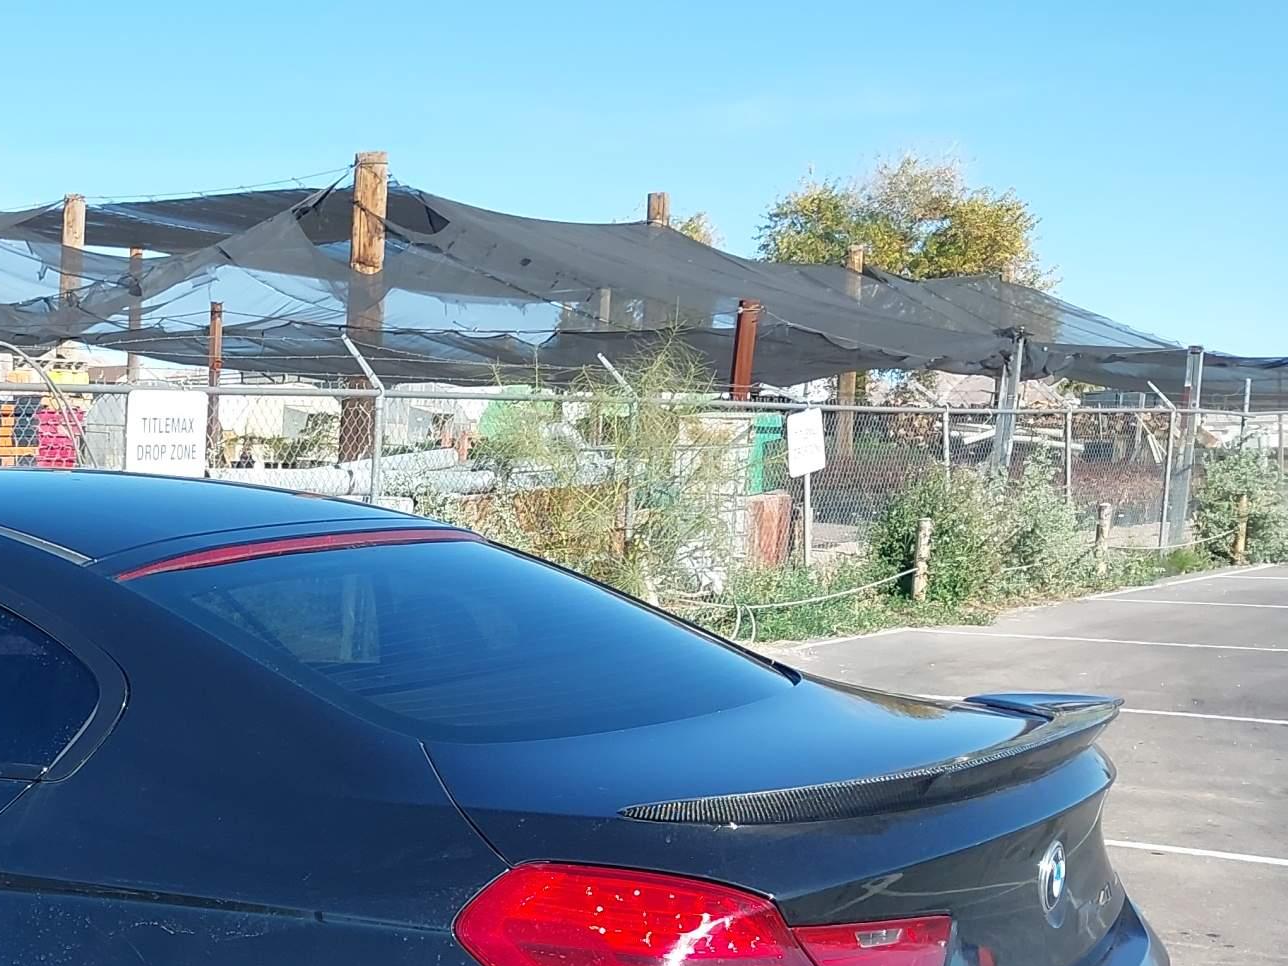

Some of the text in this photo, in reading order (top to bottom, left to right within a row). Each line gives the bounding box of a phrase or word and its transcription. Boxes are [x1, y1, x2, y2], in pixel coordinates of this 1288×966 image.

[141, 417, 194, 433] TITLEMAX
[136, 444, 196, 460] DROP ZONE
